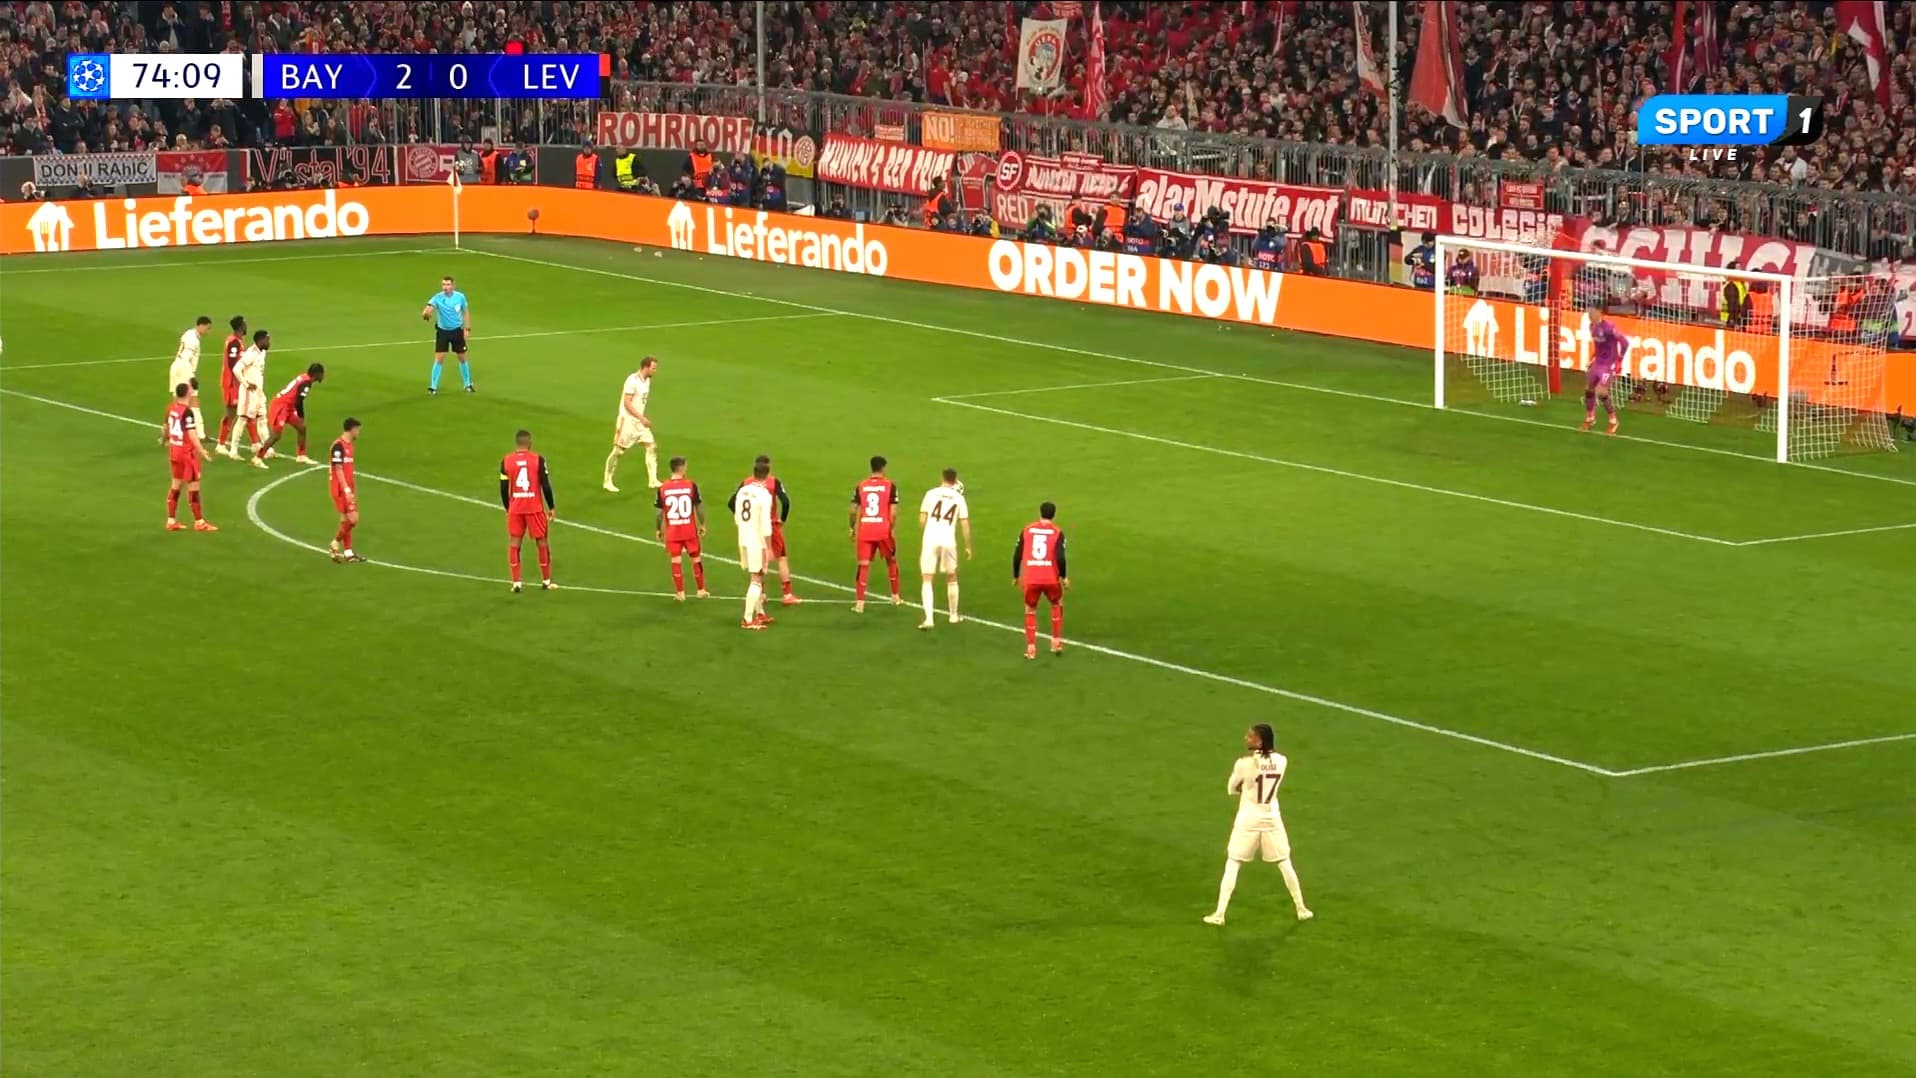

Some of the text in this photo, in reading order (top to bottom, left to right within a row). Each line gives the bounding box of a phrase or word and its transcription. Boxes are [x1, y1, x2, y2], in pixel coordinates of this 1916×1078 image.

[599, 113, 753, 153] ROHRDORF
[926, 116, 955, 144] NO!
[818, 138, 885, 186] MUNICH'S
[884, 146, 914, 188] RED
[1001, 163, 1019, 180] SF
[93, 188, 370, 250] Lieferando
[1291, 194, 1339, 238] rot
[706, 204, 888, 277] Lieferando
[988, 240, 1284, 325] ORDER NOW
[1514, 306, 1756, 394] Liefrando
[516, 467, 530, 491] 4
[665, 495, 692, 520] 20
[742, 499, 751, 522] 8
[865, 493, 880, 517] 3
[930, 500, 958, 526] 44
[1031, 534, 1047, 561] 5
[1255, 773, 1281, 805] 17
